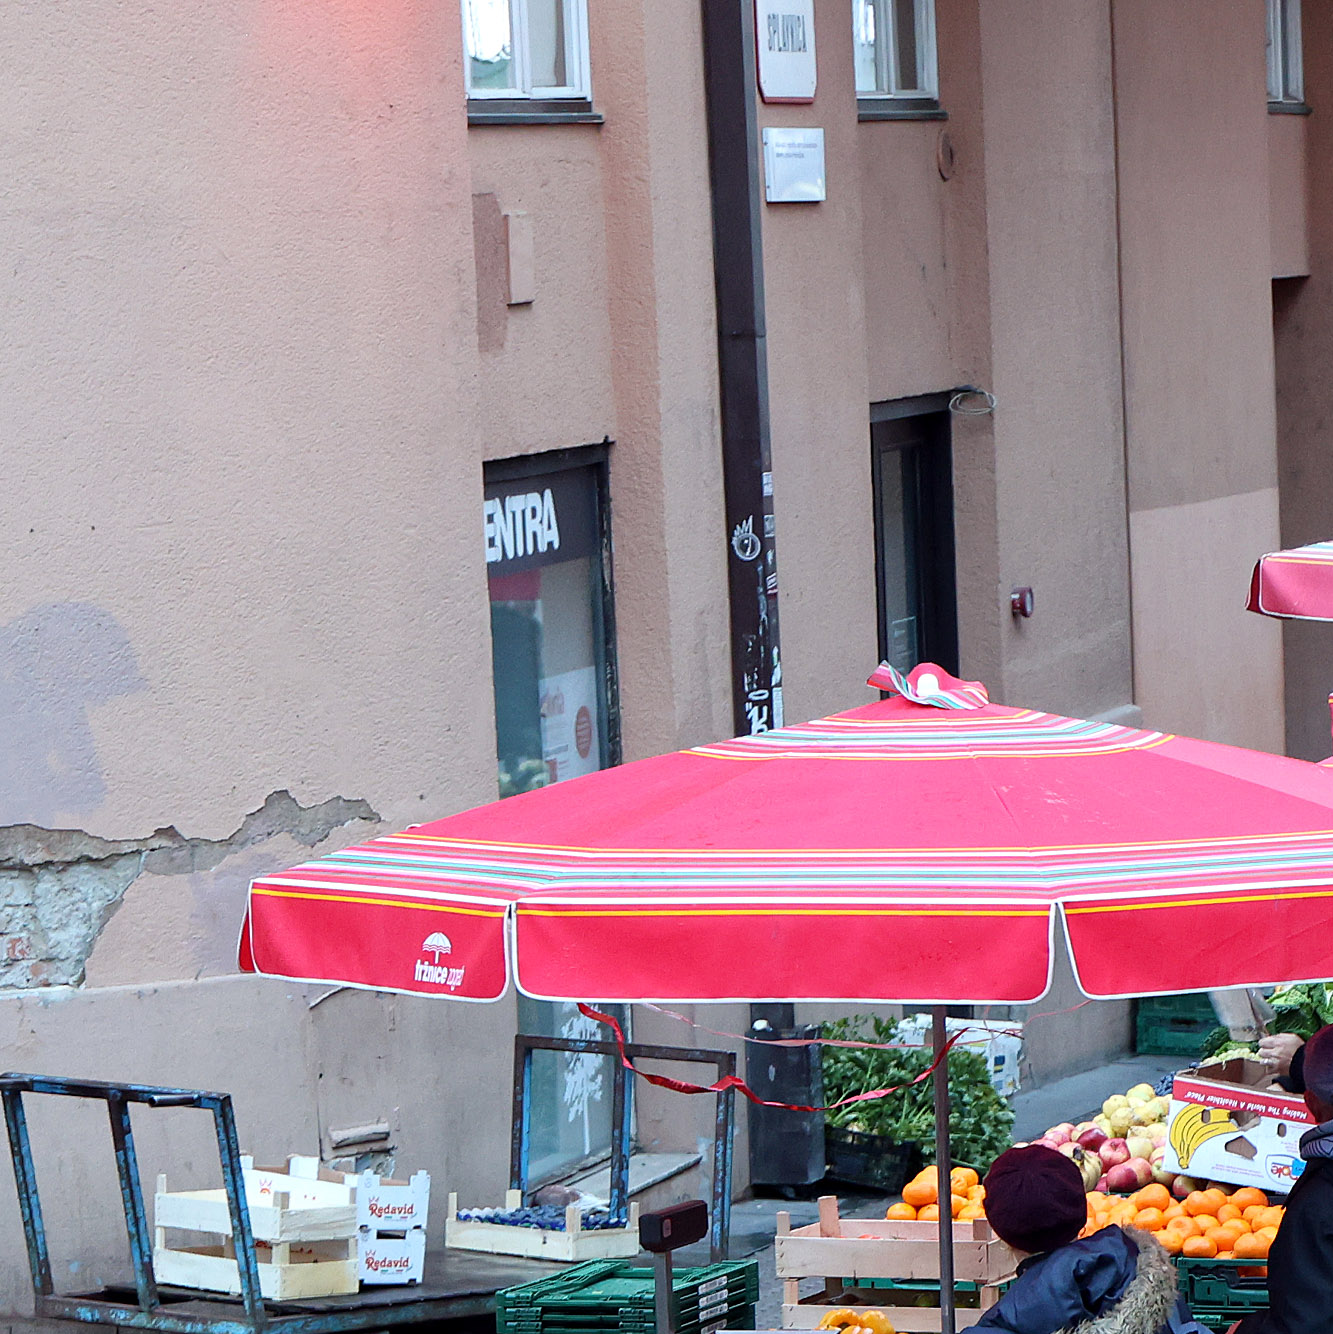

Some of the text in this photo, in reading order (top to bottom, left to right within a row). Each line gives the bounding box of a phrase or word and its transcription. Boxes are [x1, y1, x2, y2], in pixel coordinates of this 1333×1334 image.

[1247, 1101, 1266, 1113] World
[1268, 1105, 1281, 1116] The
[1282, 1107, 1307, 1119] Making
[368, 1202, 415, 1218] Redavid
[365, 1256, 410, 1272] Redavid
